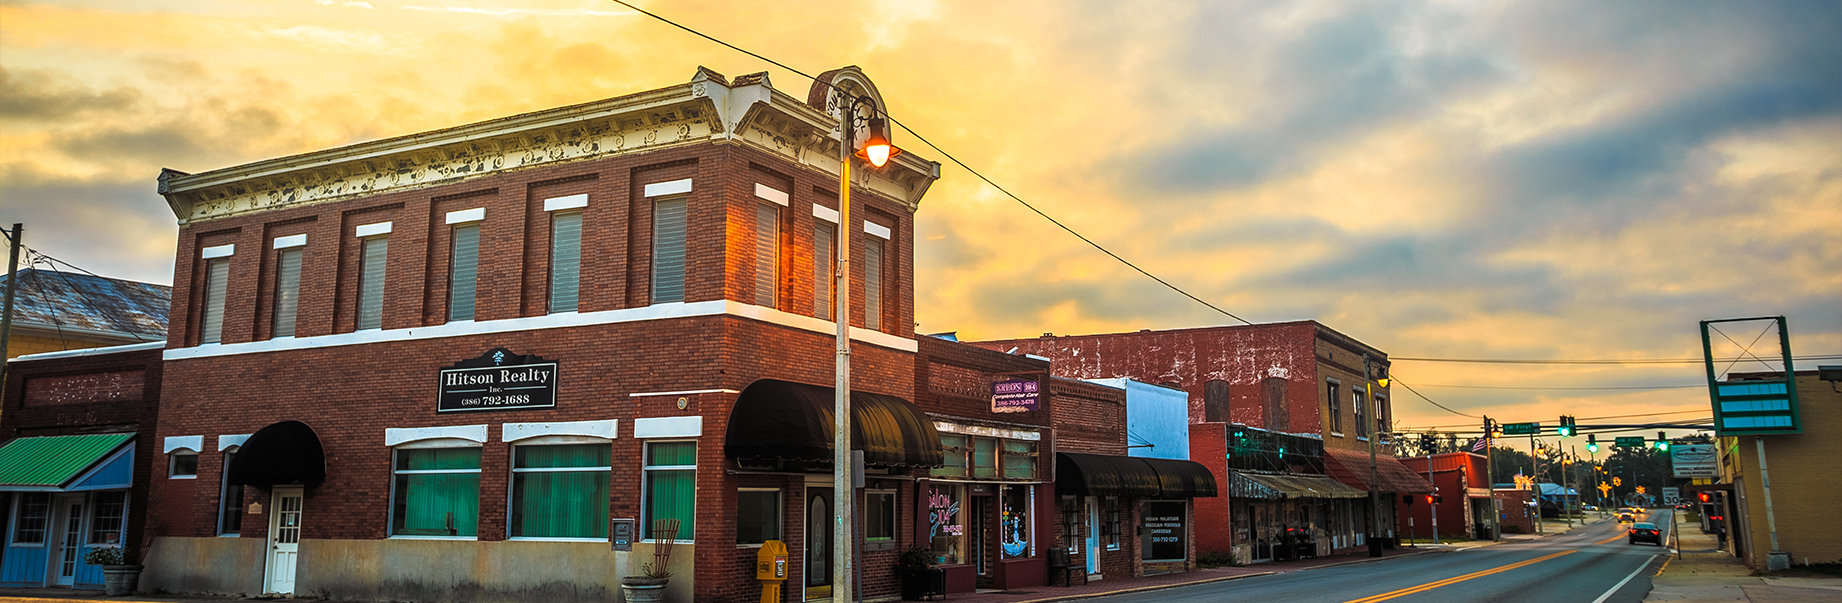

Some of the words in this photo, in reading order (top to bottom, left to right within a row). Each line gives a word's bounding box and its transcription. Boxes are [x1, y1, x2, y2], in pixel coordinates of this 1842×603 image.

[446, 373, 494, 386] Hitson
[500, 368, 550, 383] Realty
[995, 383, 1022, 393] SALON
[1024, 382, 1038, 392] 104
[461, 397, 481, 406] (386)
[482, 394, 530, 405] 792-1688
[1665, 496, 1680, 504] 30
